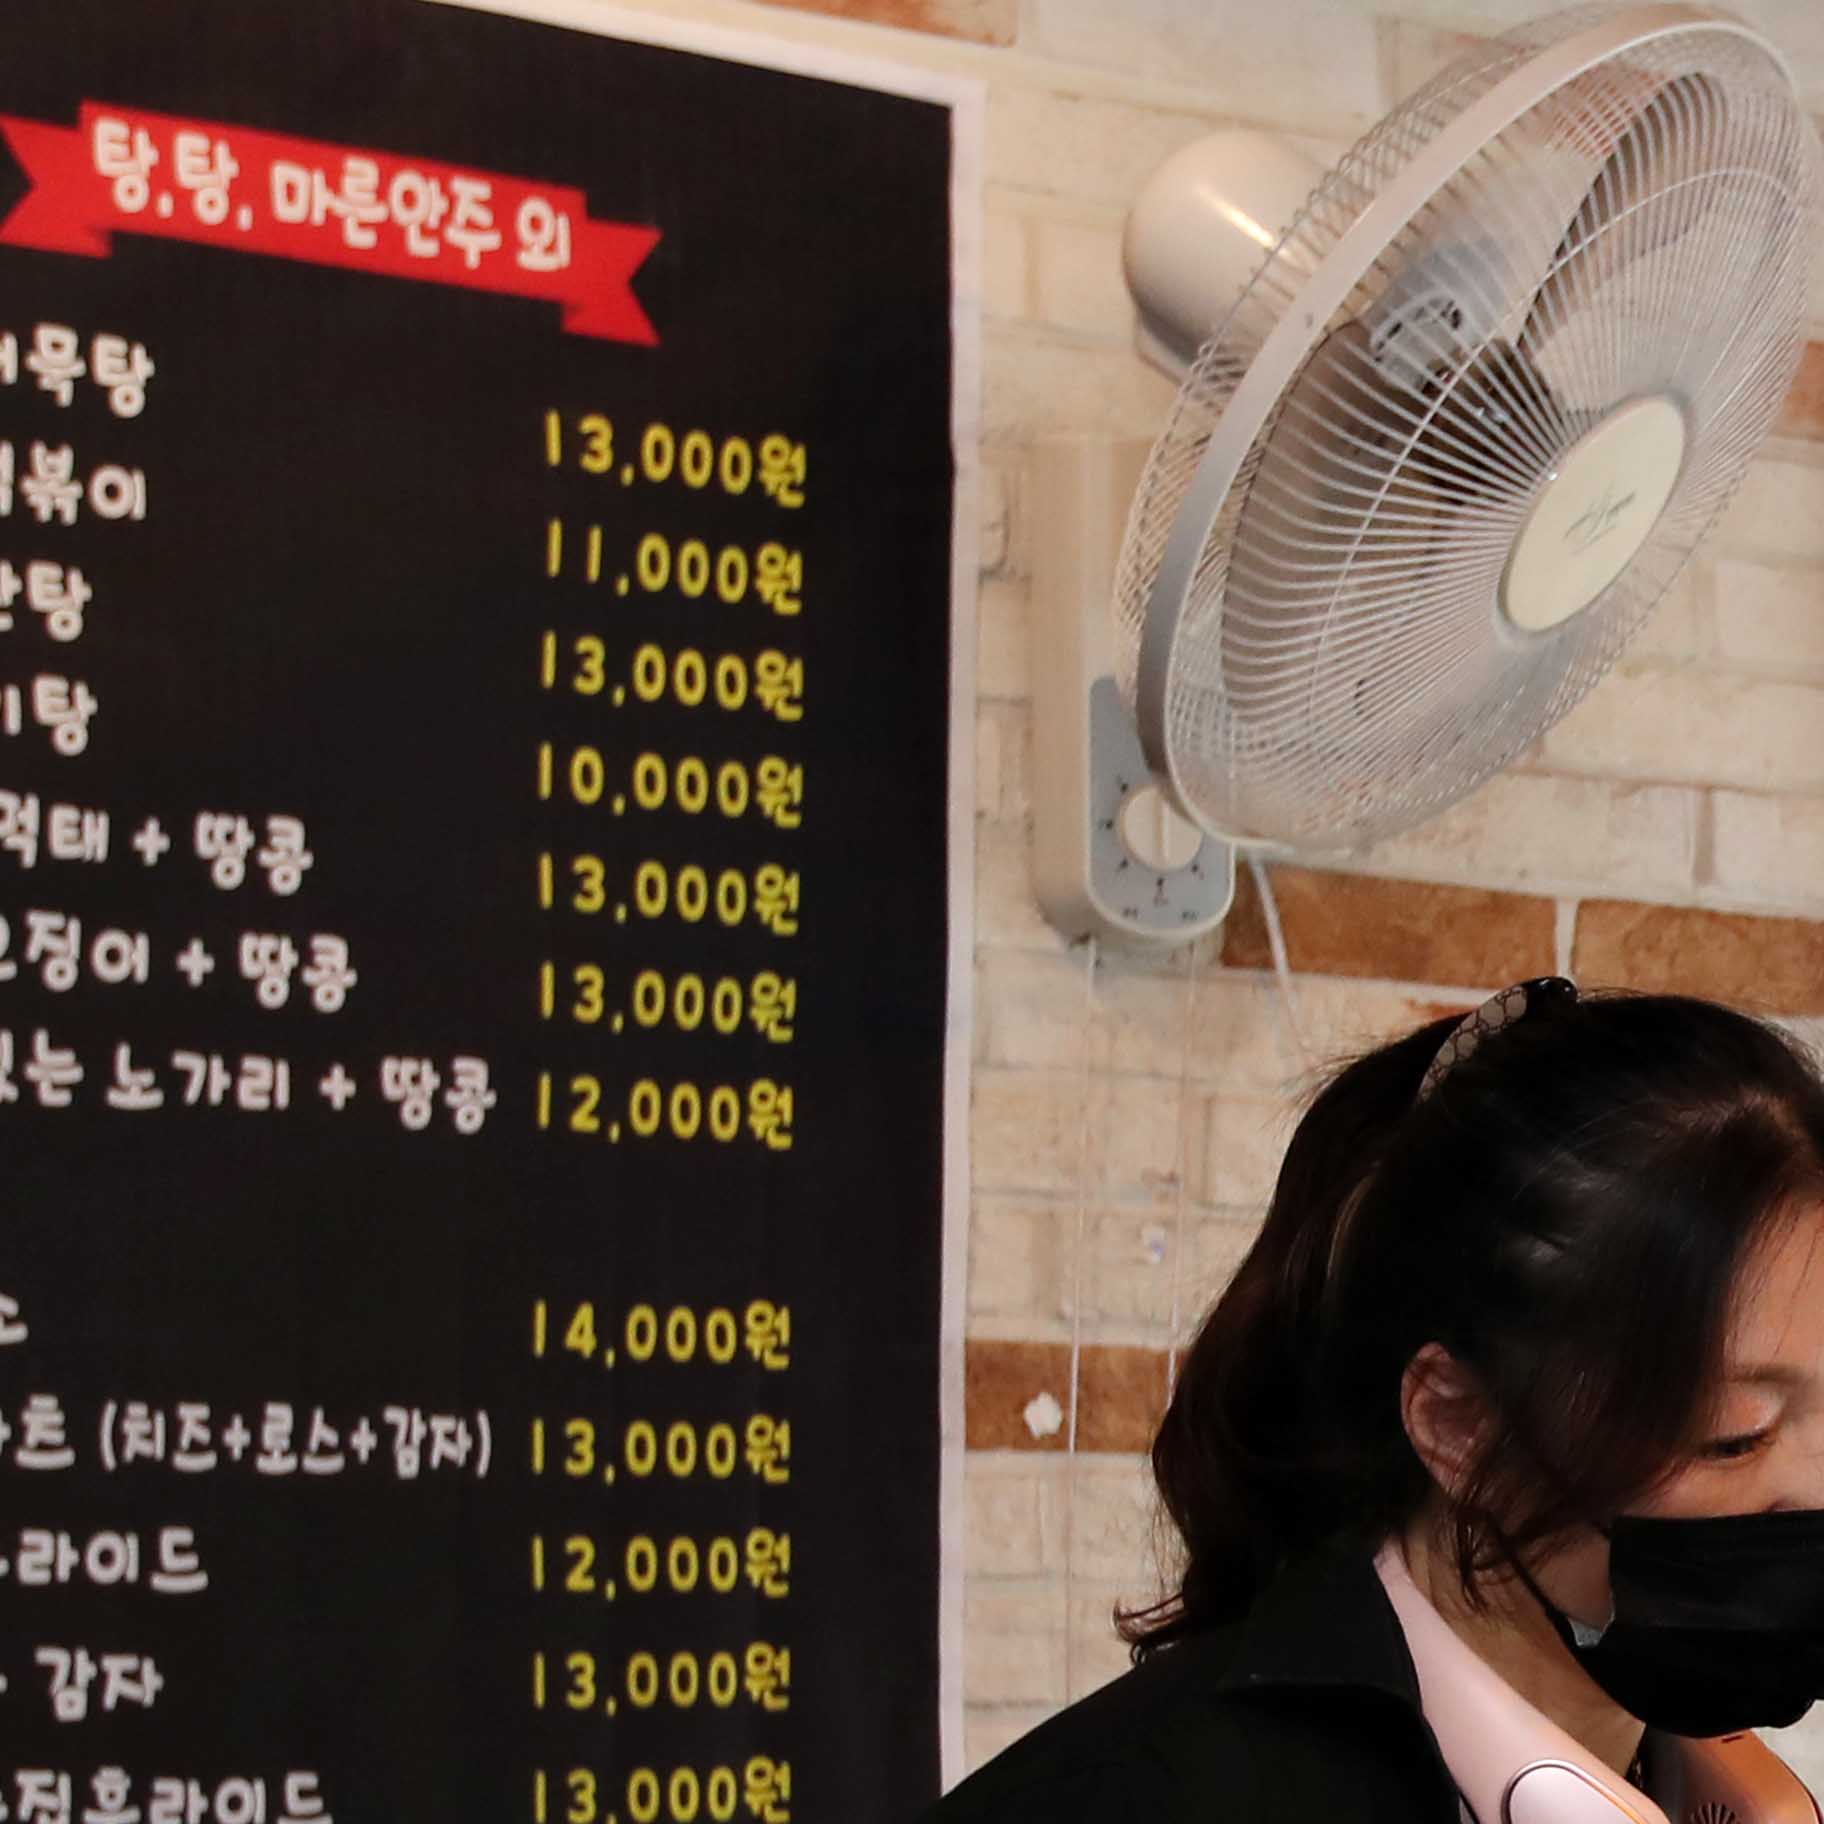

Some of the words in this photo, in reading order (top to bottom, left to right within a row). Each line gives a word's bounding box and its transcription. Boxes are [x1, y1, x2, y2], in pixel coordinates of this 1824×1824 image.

[269, 155, 503, 270] 마른안주
[514, 195, 572, 273] 외
[544, 410, 807, 508] 13,000원
[0, 440, 147, 526] 볶이
[547, 519, 803, 616] 11,000원
[541, 631, 804, 722] 13,000원
[0, 675, 99, 757] 탕
[538, 742, 804, 828] 10,000원
[132, 817, 171, 866] +
[194, 811, 315, 896] 땅콩
[538, 852, 800, 936] 13,000원
[176, 938, 216, 987] +
[238, 931, 359, 1014] 땅콩
[540, 962, 797, 1042] 13,000원
[106, 1042, 291, 1111] 노가리
[318, 1063, 357, 1111] +
[380, 1056, 498, 1135] 땅콩
[537, 1073, 794, 1150] 12,000원
[533, 1299, 791, 1370] 14,000원
[0, 1394, 76, 1470] 츠
[99, 1400, 492, 1480] (치즈+로스+감자)
[532, 1413, 791, 1484] 13,000원
[0, 1527, 209, 1594] 라이드
[532, 1528, 791, 1600] 12,000원
[34, 1646, 164, 1722] 감자
[533, 1641, 791, 1716] 13,000원
